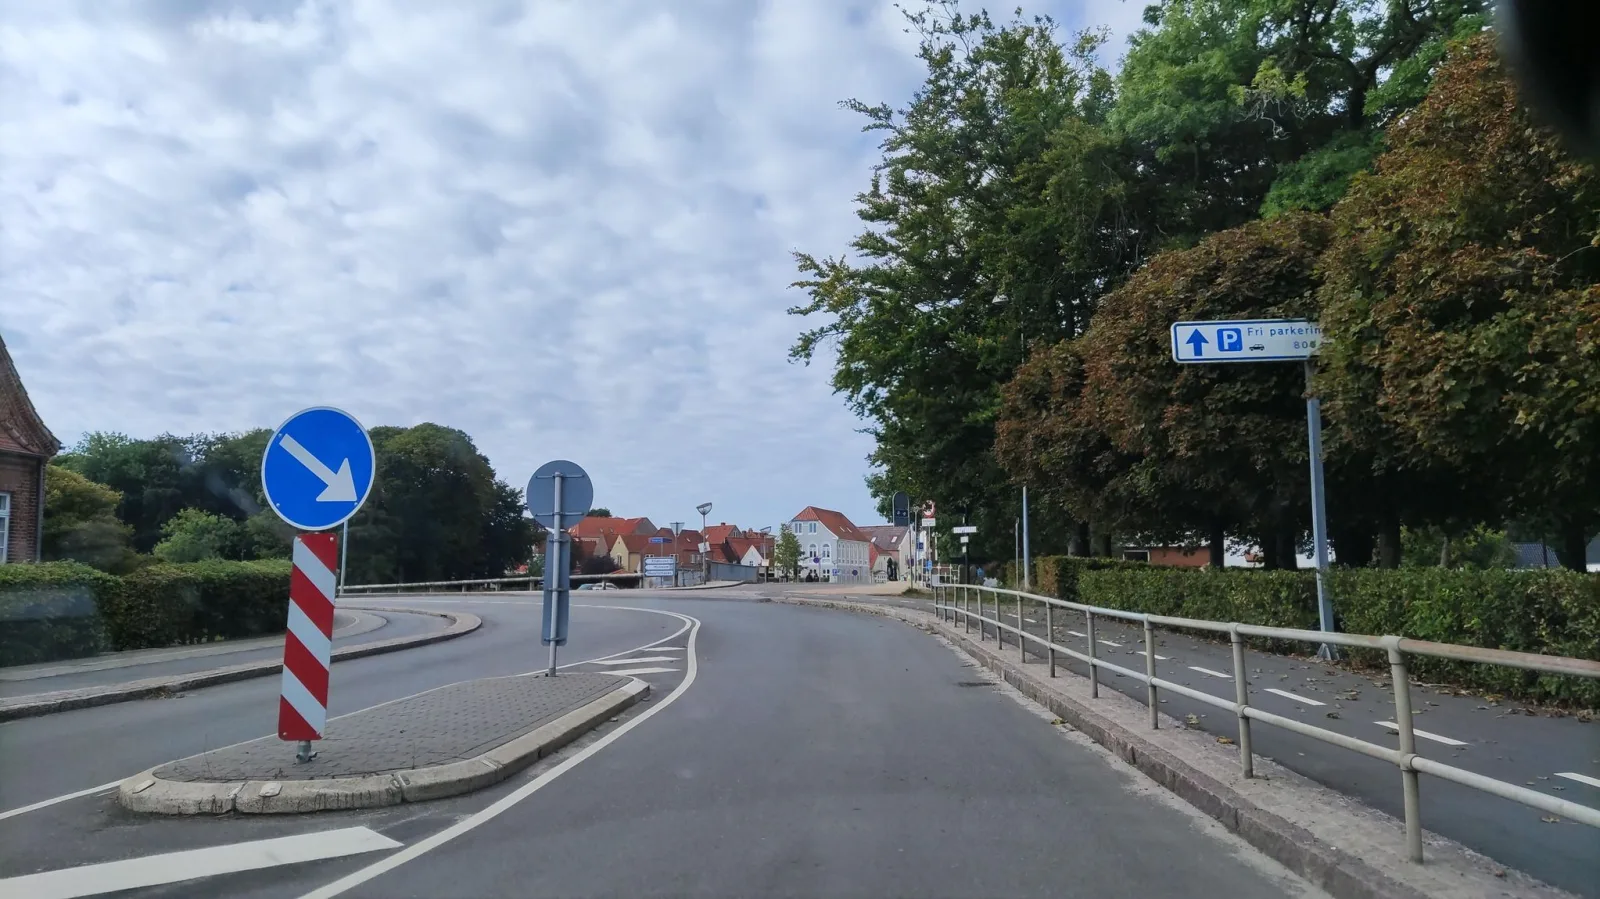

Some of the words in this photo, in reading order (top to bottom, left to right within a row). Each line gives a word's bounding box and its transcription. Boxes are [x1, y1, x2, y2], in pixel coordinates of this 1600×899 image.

[1247, 327, 1264, 336] Fri
[1270, 325, 1321, 337] parkerin
[1222, 331, 1236, 350] P
